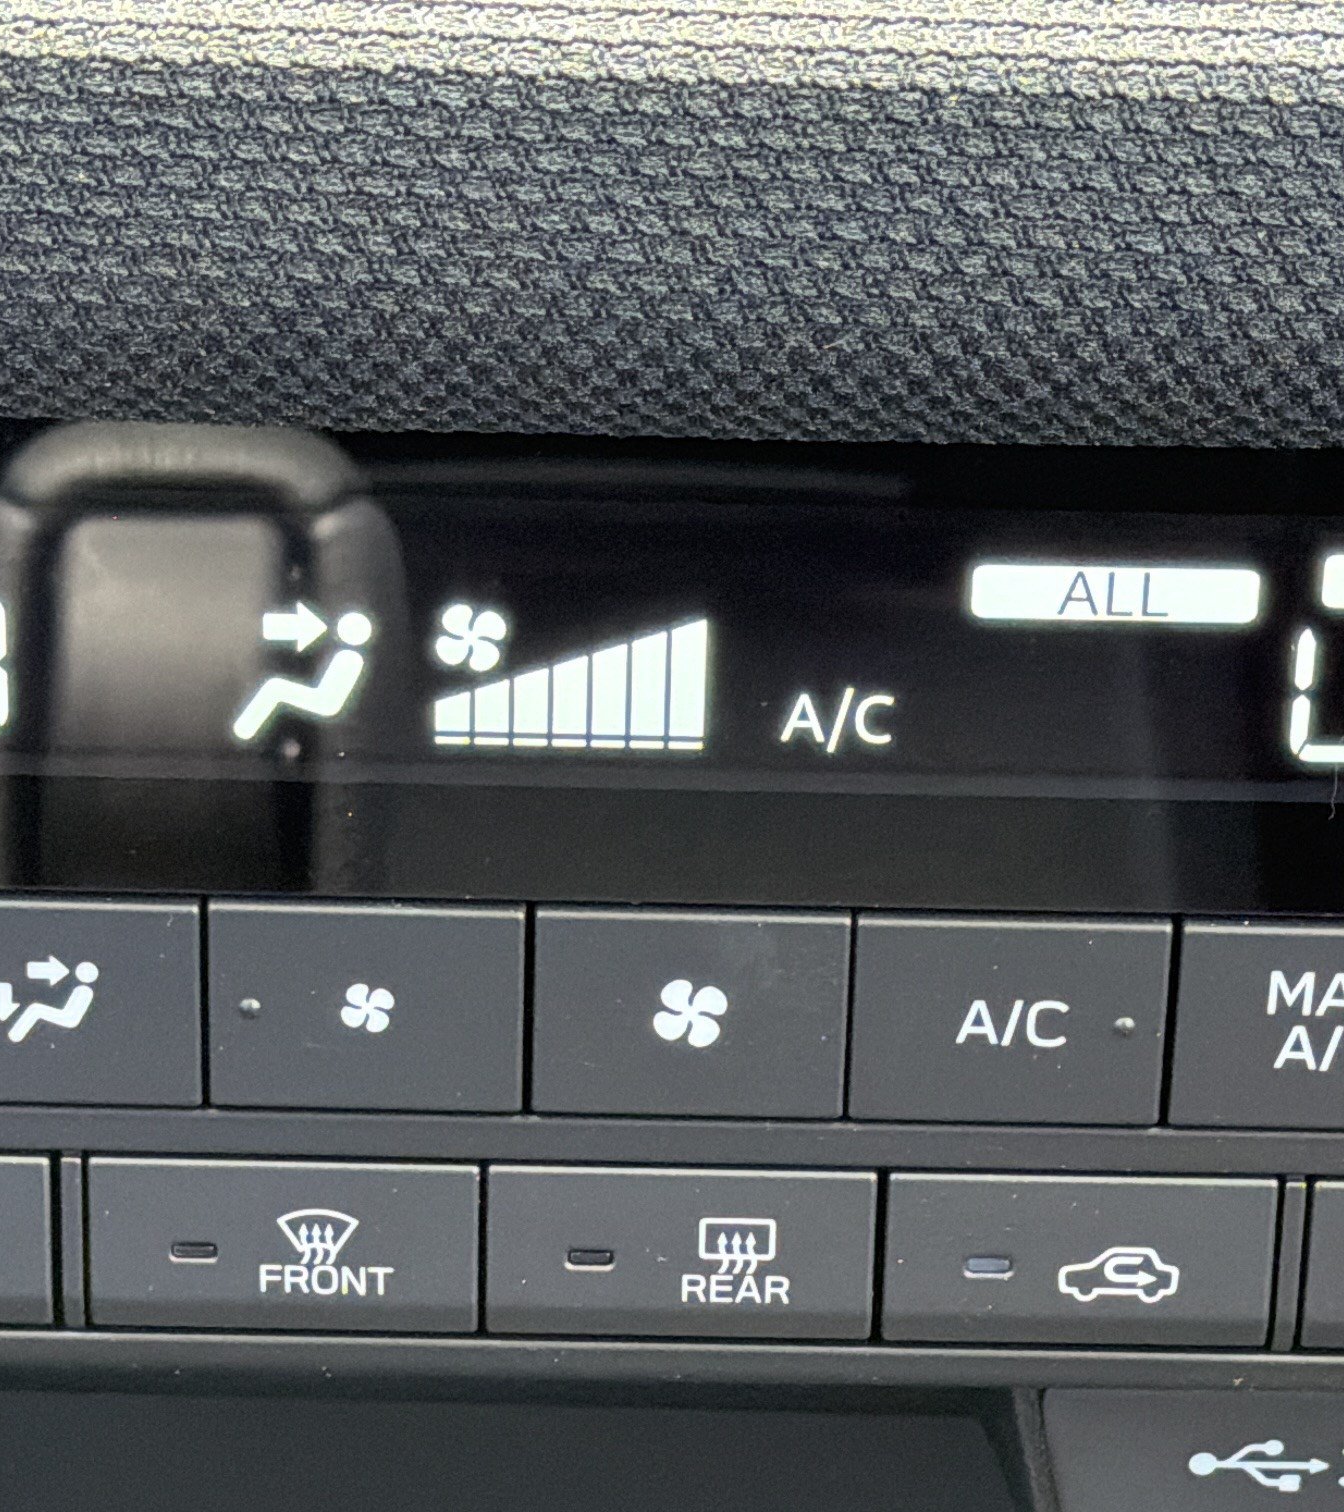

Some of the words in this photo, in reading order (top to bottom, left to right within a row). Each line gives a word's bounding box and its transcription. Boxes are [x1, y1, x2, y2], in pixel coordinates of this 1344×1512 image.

[1057, 570, 1169, 618] ALL
[779, 685, 895, 754] A/C
[955, 998, 1070, 1049] A/C
[258, 1261, 396, 1298] FRONT
[680, 1271, 791, 1305] REAR
